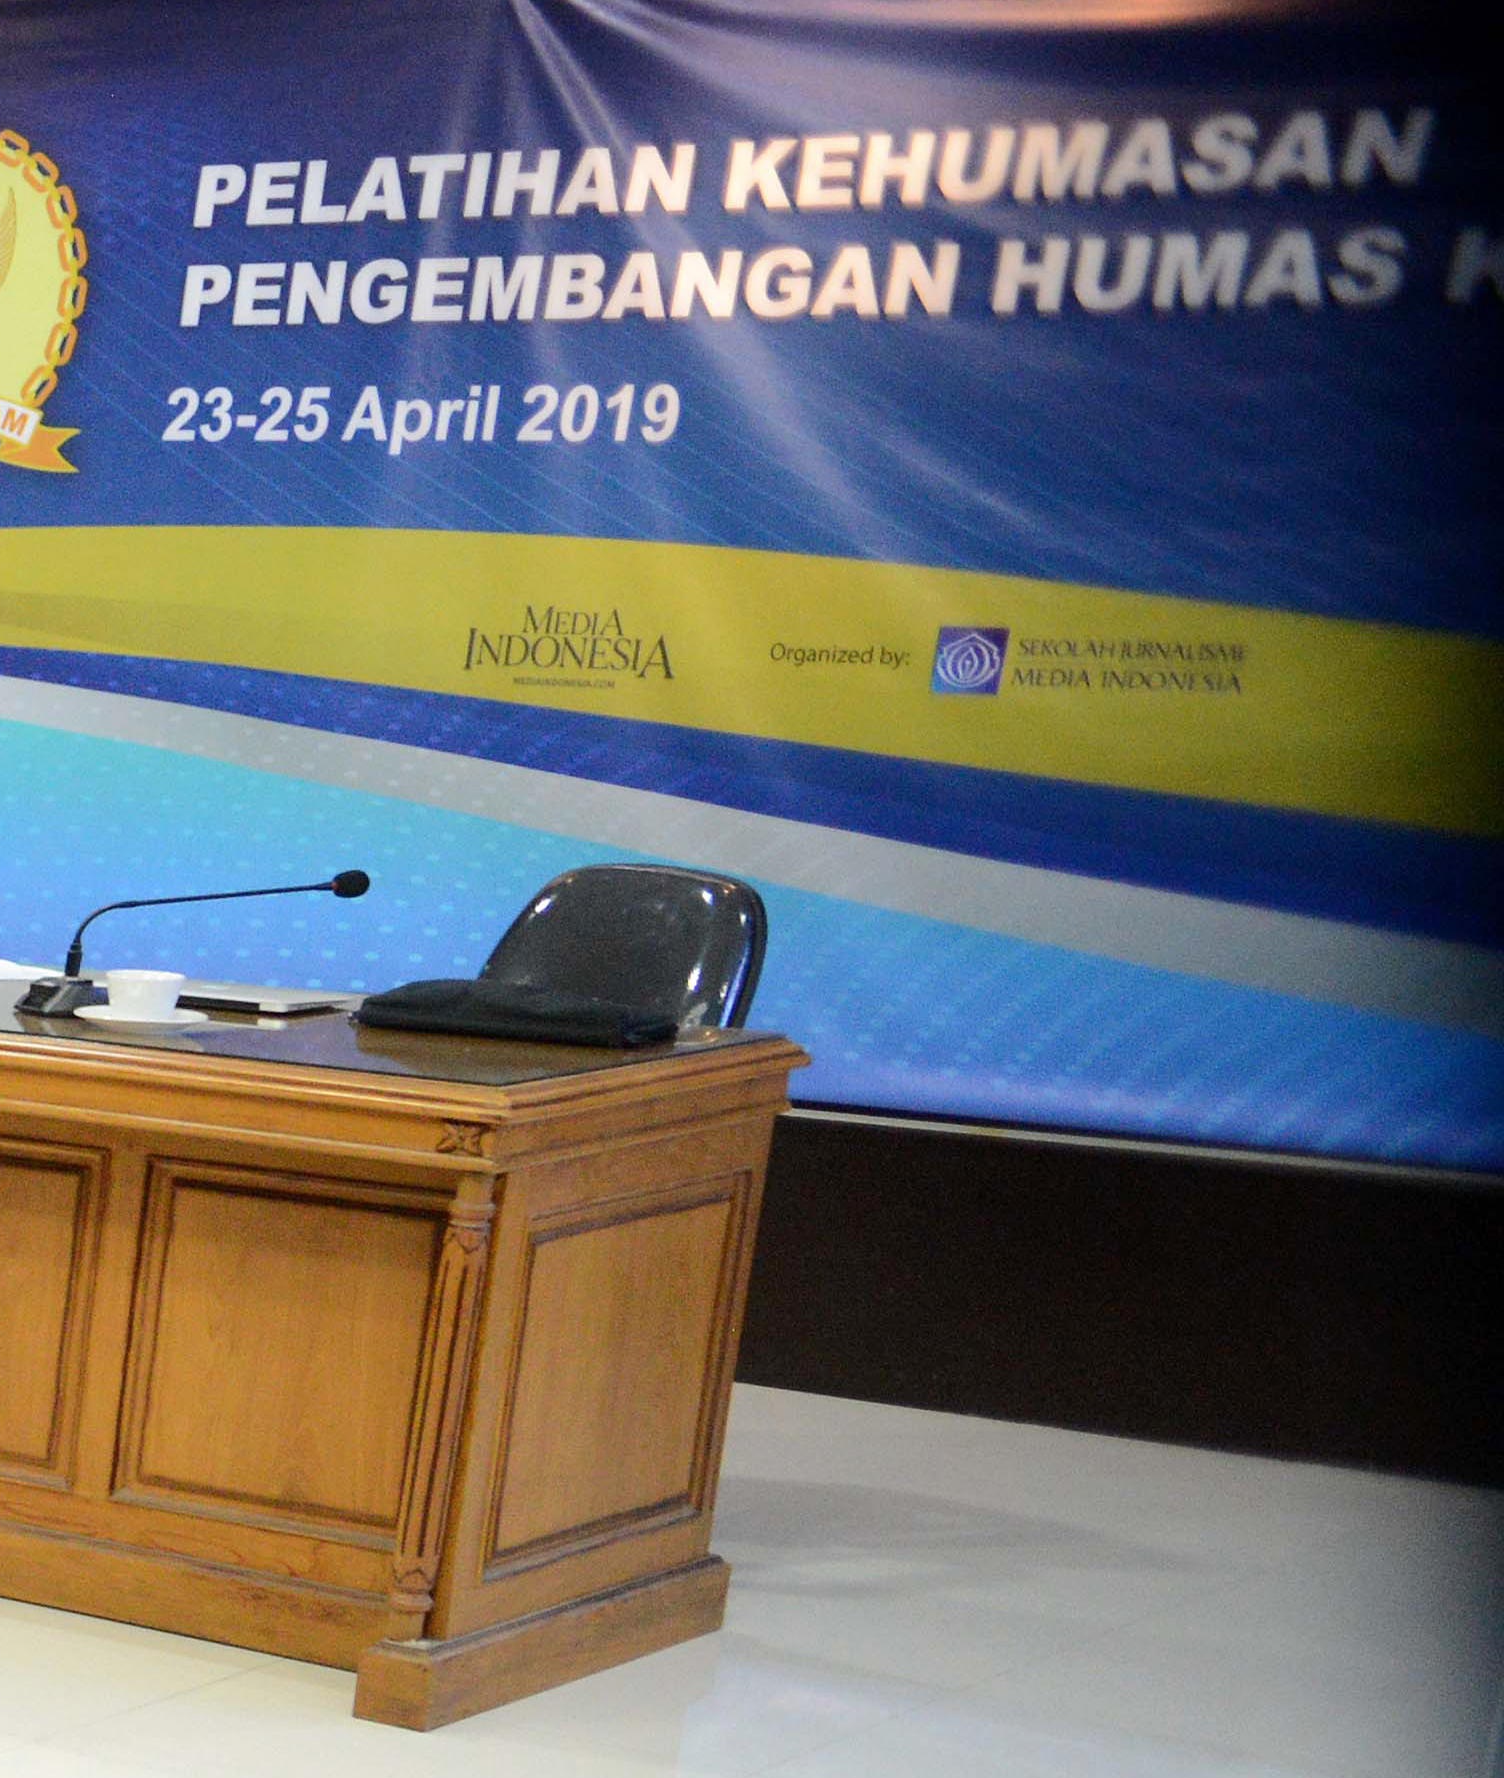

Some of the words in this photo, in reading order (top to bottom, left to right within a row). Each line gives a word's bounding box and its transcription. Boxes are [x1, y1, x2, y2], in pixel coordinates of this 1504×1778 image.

[193, 144, 695, 227] PELATIHAN
[723, 109, 1433, 213] KEHUMASAN
[180, 242, 962, 327] PENGEMBANGAN
[991, 224, 1408, 316] HUMAS
[162, 385, 331, 442] 23-25
[341, 384, 502, 456] April
[516, 383, 681, 442] 2019
[522, 605, 624, 636] MEDIA
[463, 627, 675, 679] INDONESIA
[770, 642, 874, 668] Organized
[879, 646, 910, 669] by:
[1011, 667, 1091, 689] MEDIA
[1101, 670, 1242, 694] INDONESIA
